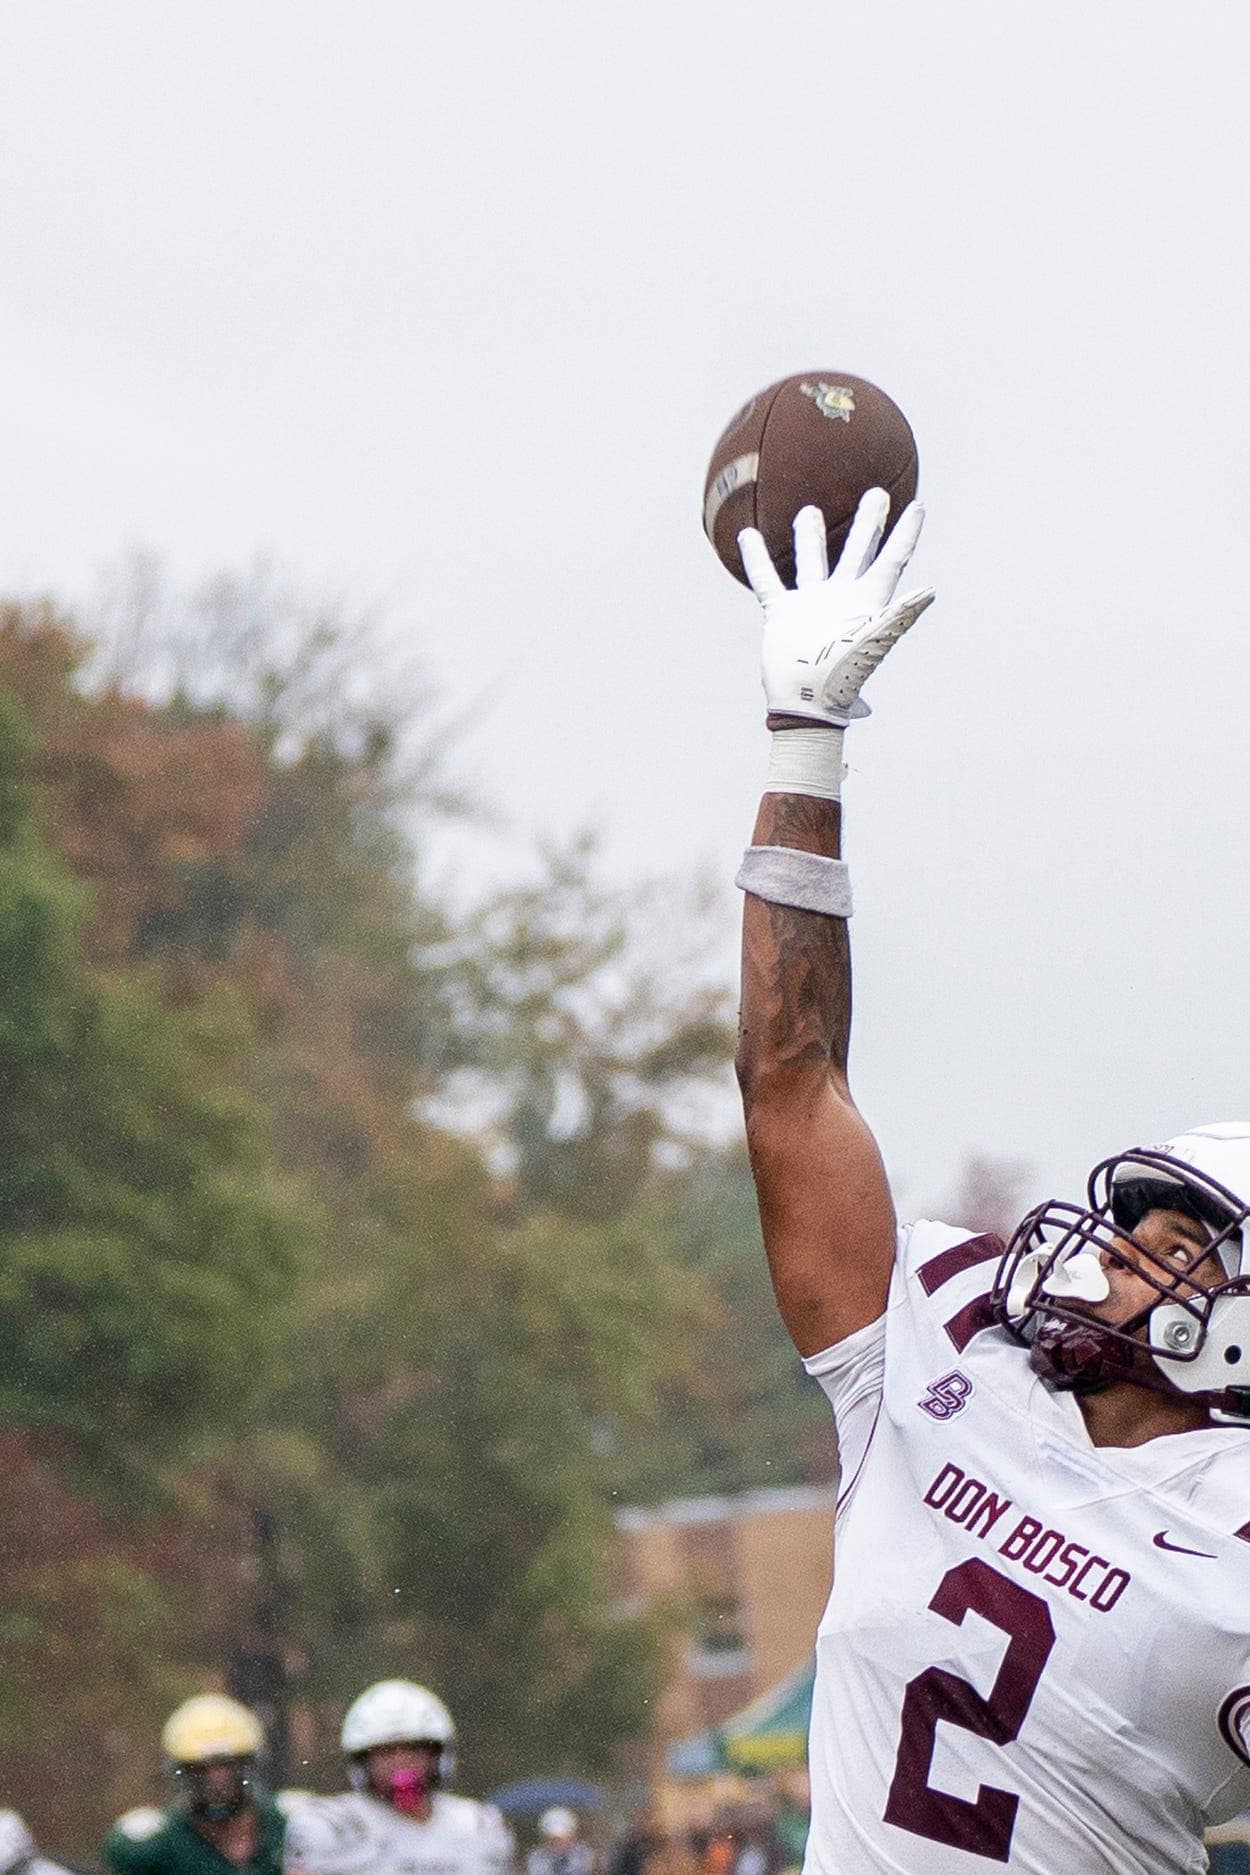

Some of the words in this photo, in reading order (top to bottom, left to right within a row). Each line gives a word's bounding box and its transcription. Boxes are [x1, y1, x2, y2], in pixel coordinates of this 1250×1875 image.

[923, 1461, 1013, 1540] DON
[998, 1514, 1131, 1613] BOSCO
[882, 1556, 1057, 1863] 2
